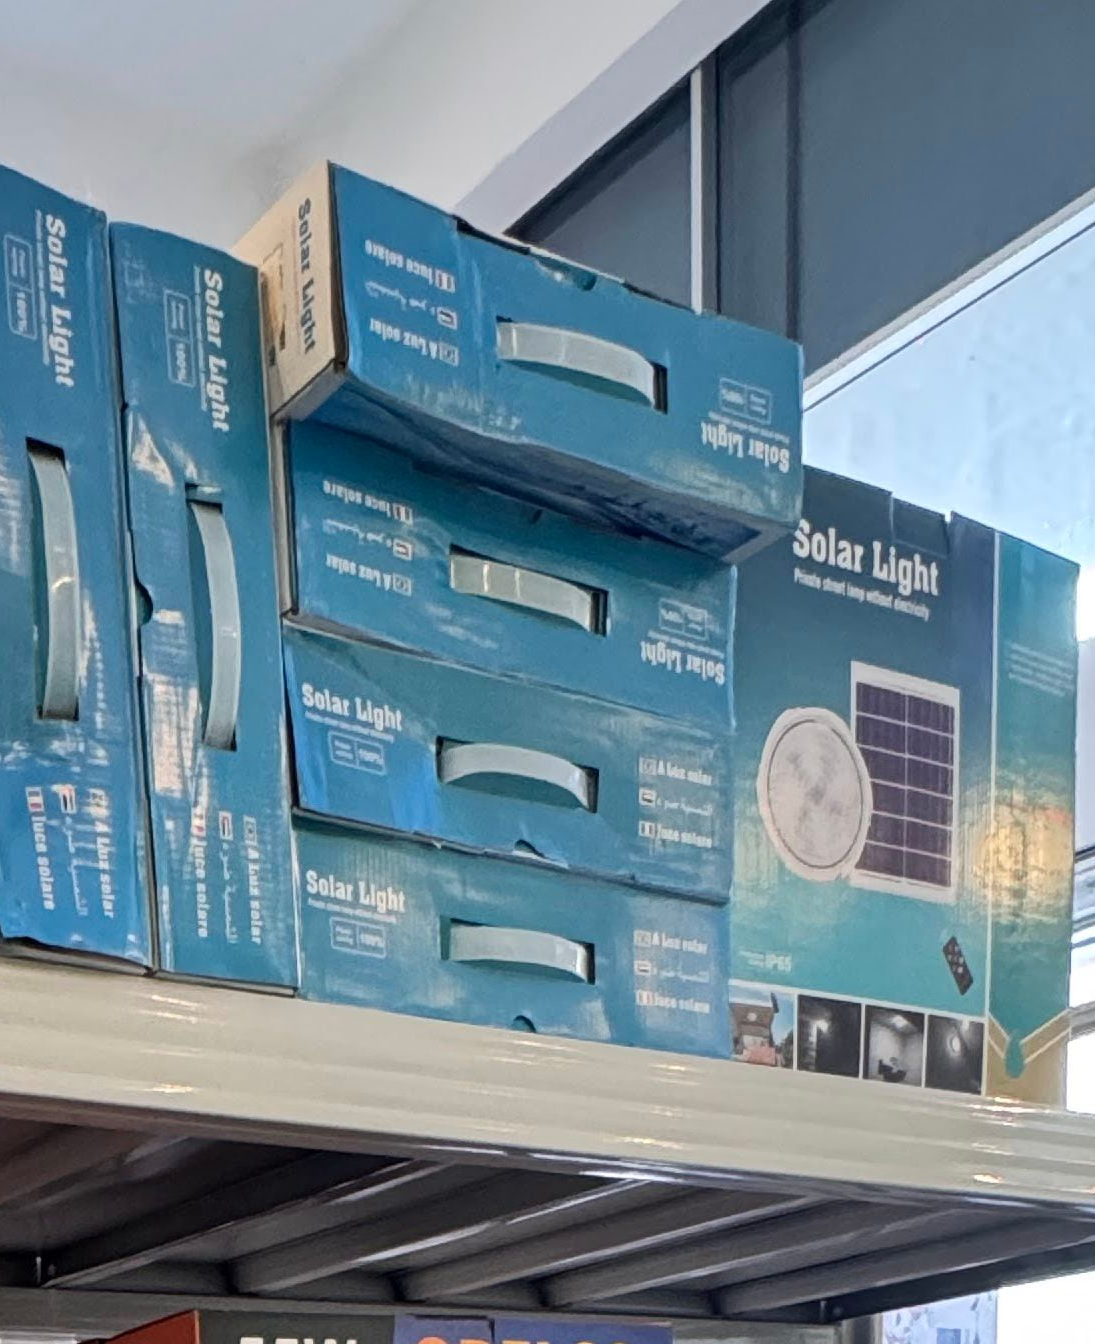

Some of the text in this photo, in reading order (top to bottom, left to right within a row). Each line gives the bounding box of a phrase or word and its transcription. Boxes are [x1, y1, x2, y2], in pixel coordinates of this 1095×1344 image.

[298, 198, 313, 273] Solar
[46, 213, 75, 388] Solar Light
[204, 268, 230, 432] Solar Light
[701, 421, 791, 474] Solar Light
[793, 518, 940, 597] Solar Light
[302, 682, 403, 732] Solar Light
[306, 869, 406, 914] Solar Light
